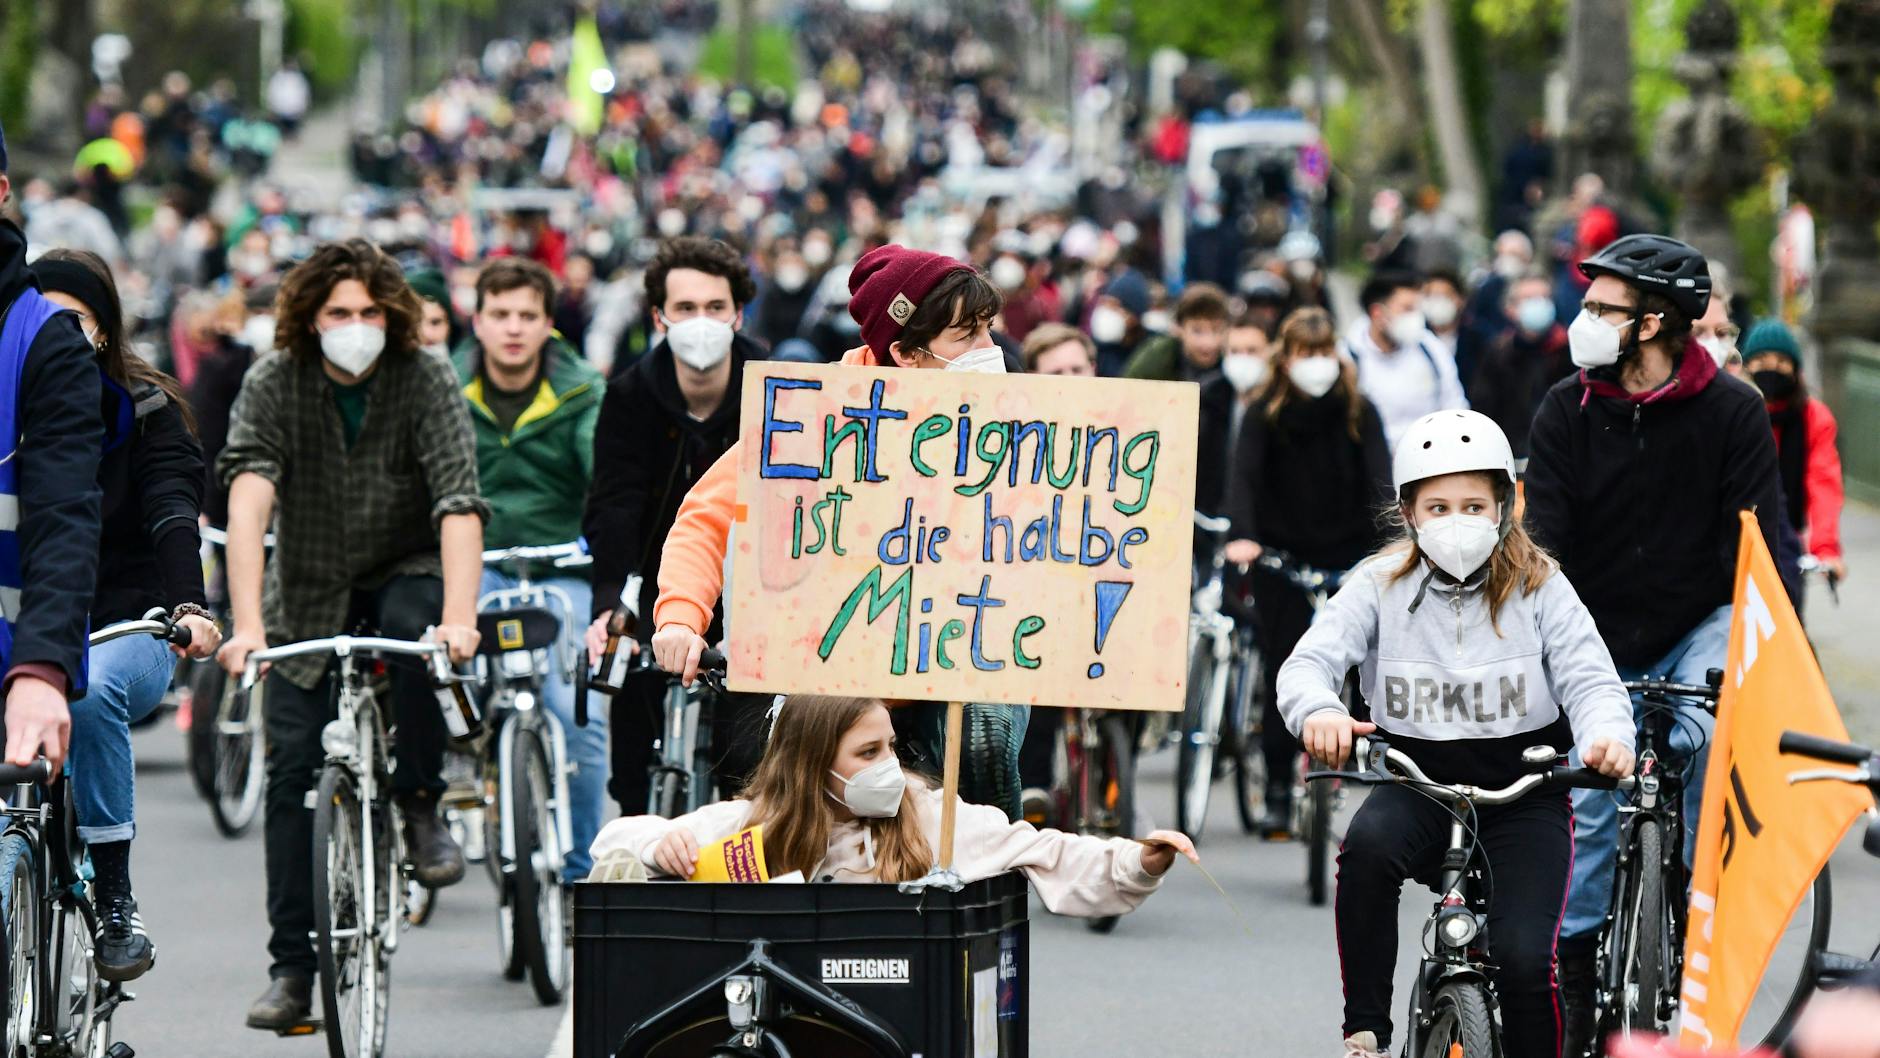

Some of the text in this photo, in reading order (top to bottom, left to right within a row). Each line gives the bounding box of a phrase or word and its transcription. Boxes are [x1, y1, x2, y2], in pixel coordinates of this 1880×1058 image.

[760, 376, 1160, 517] Enteignung
[791, 485, 1149, 570] ist die halbe
[1385, 673, 1528, 723] BRKLN
[821, 958, 910, 978] ENTEIGNEN
